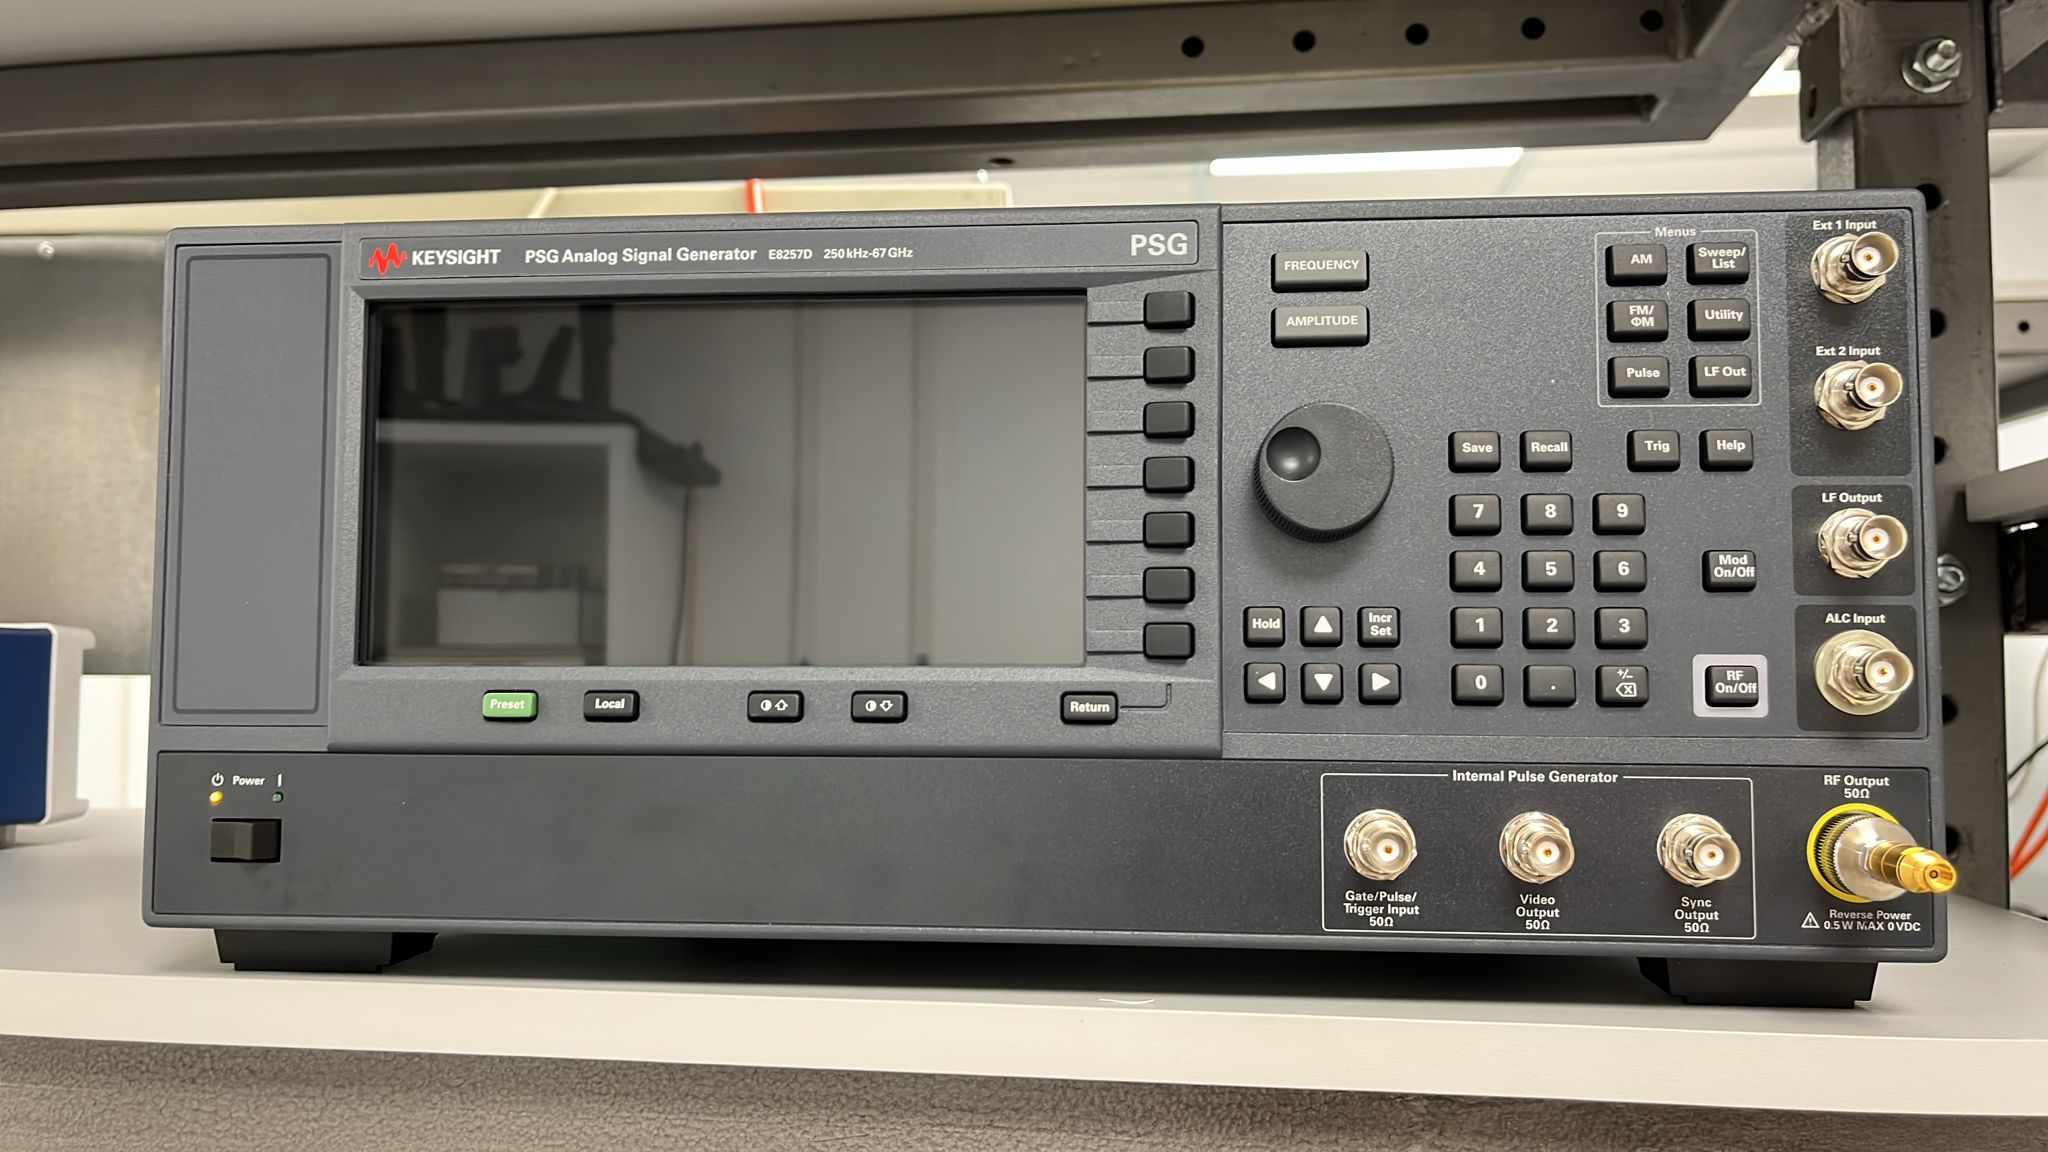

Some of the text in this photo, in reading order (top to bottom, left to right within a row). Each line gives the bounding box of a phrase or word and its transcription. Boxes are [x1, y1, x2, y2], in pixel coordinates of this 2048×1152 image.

[1812, 219, 1878, 231] Ext 1 Input
[1654, 226, 1697, 238] Menus
[1130, 232, 1188, 256] PSG
[411, 248, 502, 266] KEYSIGHT
[525, 248, 559, 264] PSG
[561, 248, 618, 266] Analog
[621, 247, 673, 265] Signal
[676, 246, 758, 262] Generator
[768, 248, 813, 260] E8257D
[1630, 253, 1653, 265] AM
[1698, 246, 1747, 259] Sweep/
[1284, 259, 1360, 271] FREQUENCY
[1711, 258, 1736, 269] List
[1628, 304, 1655, 316] FM/
[1704, 309, 1744, 322] Utility
[1285, 314, 1359, 327] AMPLITUDE
[1815, 345, 1882, 358] Ext 2 Input
[1626, 367, 1661, 378] Pulse
[1703, 365, 1747, 377] LF Out
[1462, 442, 1493, 453] Save
[1530, 441, 1569, 453] Recall
[1644, 440, 1671, 453] Trig
[1716, 439, 1746, 453] Help
[1821, 492, 1883, 505] LF Output
[1472, 503, 1485, 519] 7
[1544, 503, 1557, 519] 8
[1616, 502, 1629, 518] 9
[1718, 554, 1748, 566] Mod
[1473, 560, 1486, 576] 4
[1545, 561, 1558, 577] 5
[1617, 560, 1630, 576] 6
[1713, 566, 1756, 578] On/Off
[1252, 617, 1281, 629] Hold
[1368, 612, 1393, 624] Incr
[1825, 612, 1886, 626] ALC Input
[1370, 624, 1393, 636] Set
[1475, 617, 1485, 633] 1
[1546, 617, 1559, 633] 2
[1618, 617, 1631, 634] 3
[1726, 669, 1744, 681] RF
[1475, 674, 1488, 690] 0
[1714, 681, 1758, 694] On/Off
[489, 698, 525, 710] Preset
[594, 697, 626, 709] Local
[1070, 700, 1111, 713] Return
[232, 775, 266, 786] Power
[1452, 769, 1619, 783] Internal Pulse Generator
[1823, 774, 1890, 788] RF Output
[1519, 893, 1556, 906] Video
[1680, 896, 1713, 910] Sync
[1343, 902, 1420, 917] Trigger Input
[1515, 906, 1561, 919] Output
[1674, 908, 1720, 922] Output
[1829, 909, 1912, 920] Reverse Power
[1856, 920, 1885, 931] MAX
